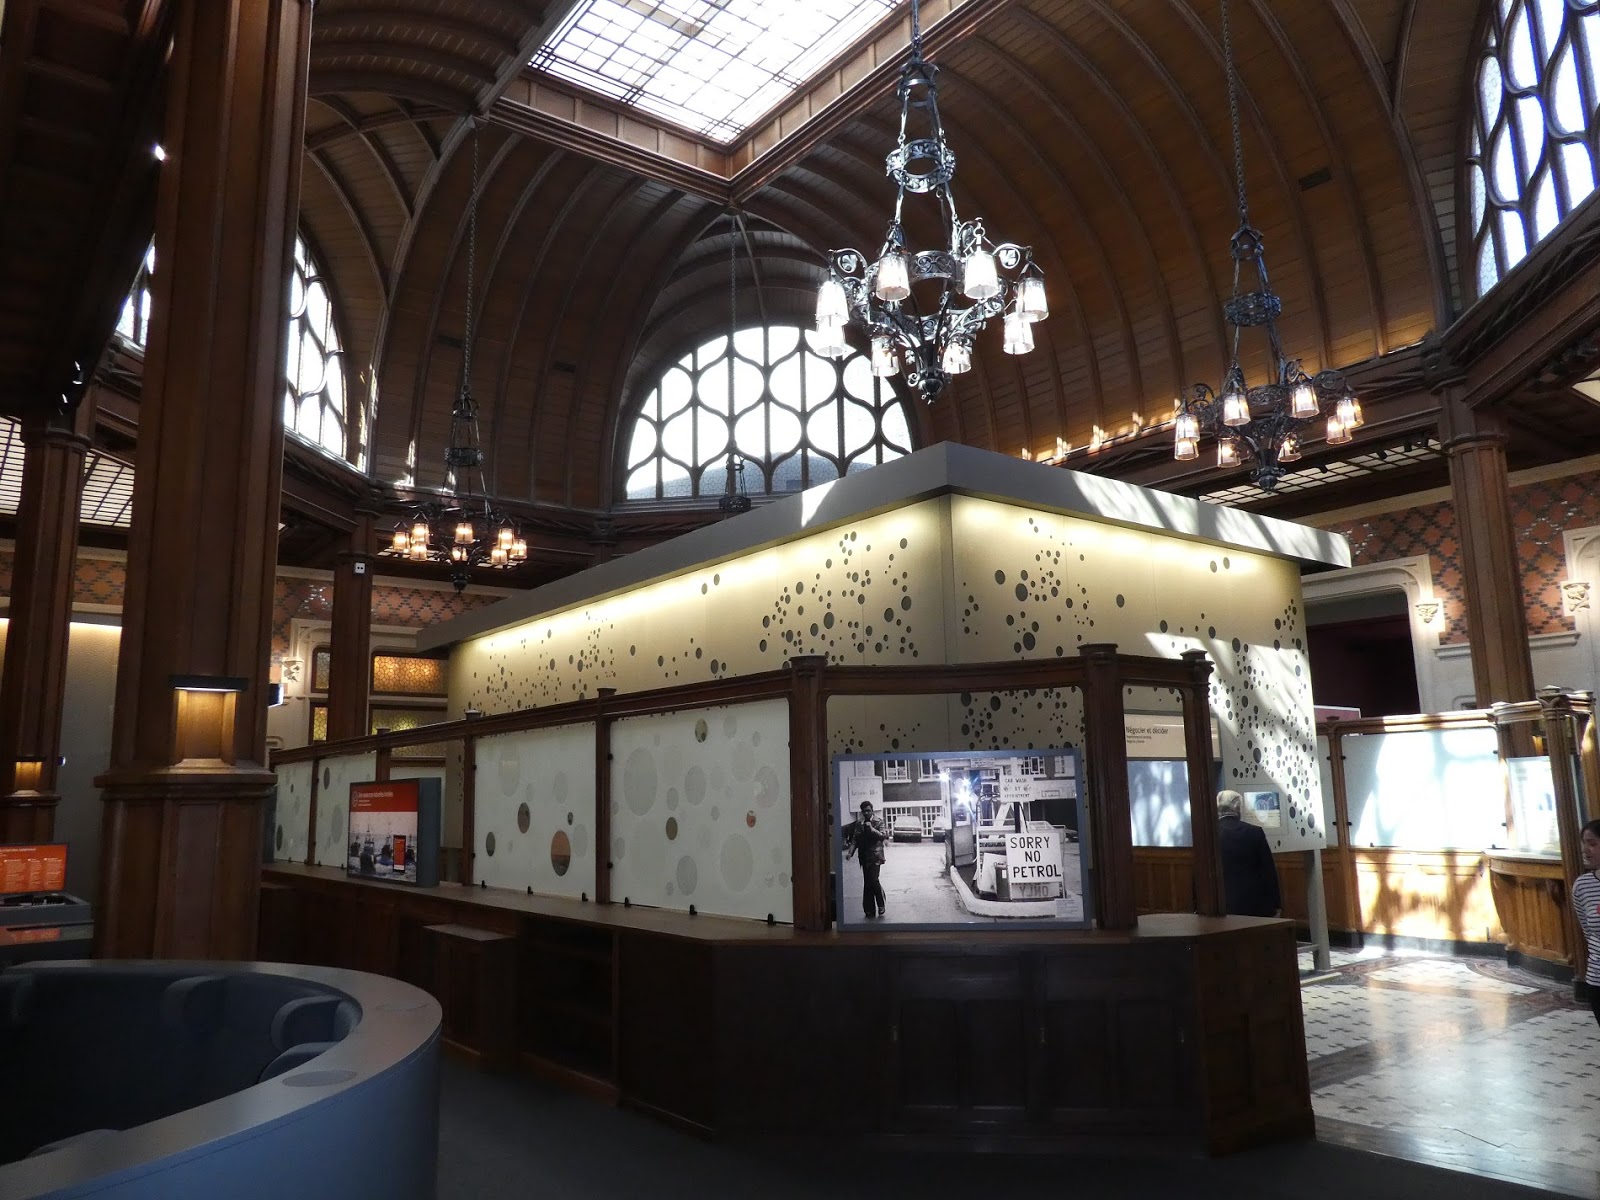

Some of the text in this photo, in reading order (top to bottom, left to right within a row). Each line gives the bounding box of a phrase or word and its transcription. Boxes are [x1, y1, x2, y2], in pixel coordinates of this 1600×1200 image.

[1010, 836, 1050, 849] SORRY
[1024, 850, 1041, 863] NO
[1012, 864, 1061, 878] PETROL
